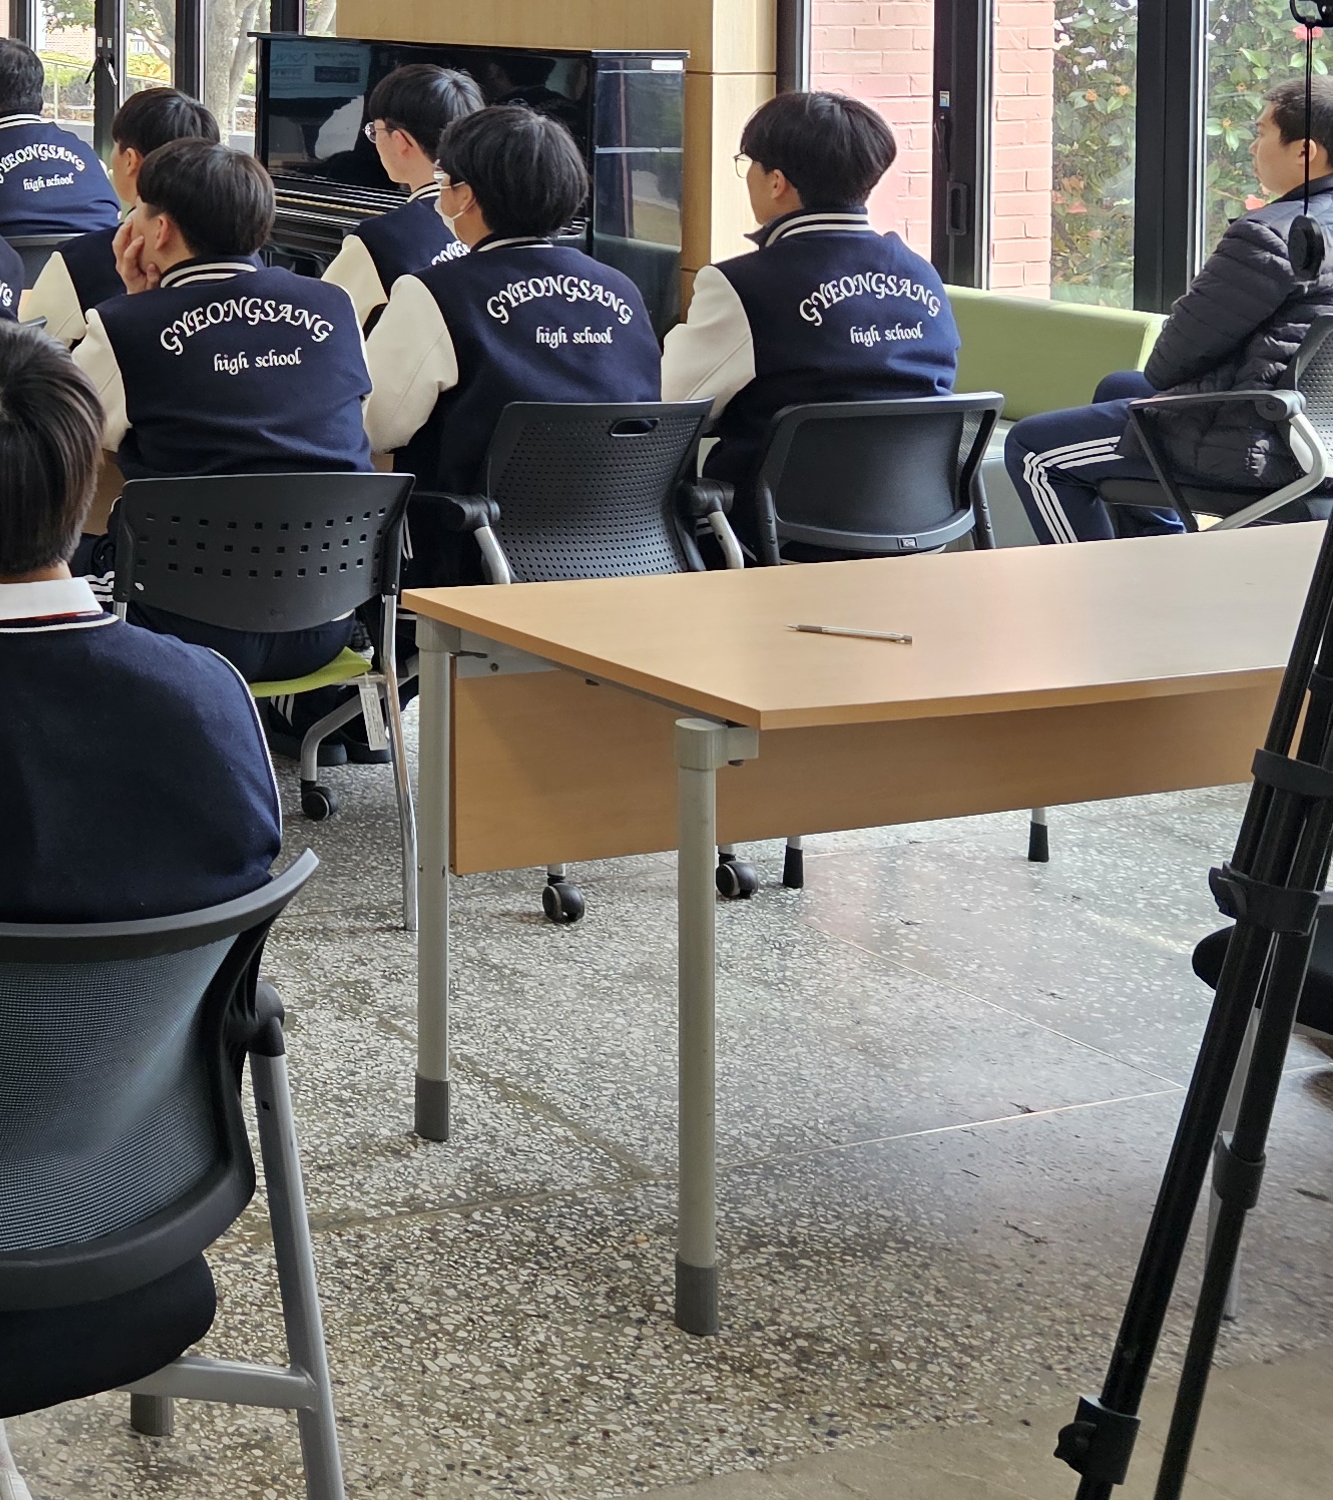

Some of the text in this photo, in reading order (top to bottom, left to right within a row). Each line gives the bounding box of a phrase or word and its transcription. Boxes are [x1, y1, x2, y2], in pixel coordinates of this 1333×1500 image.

[22, 172, 74, 192] high school
[486, 274, 633, 324] GYEONGSANG
[799, 272, 941, 327] GYEONGSANG
[159, 296, 334, 355] GYEONGSANG
[535, 326, 613, 349] high school
[849, 321, 923, 348] high school
[213, 347, 301, 375] high school
